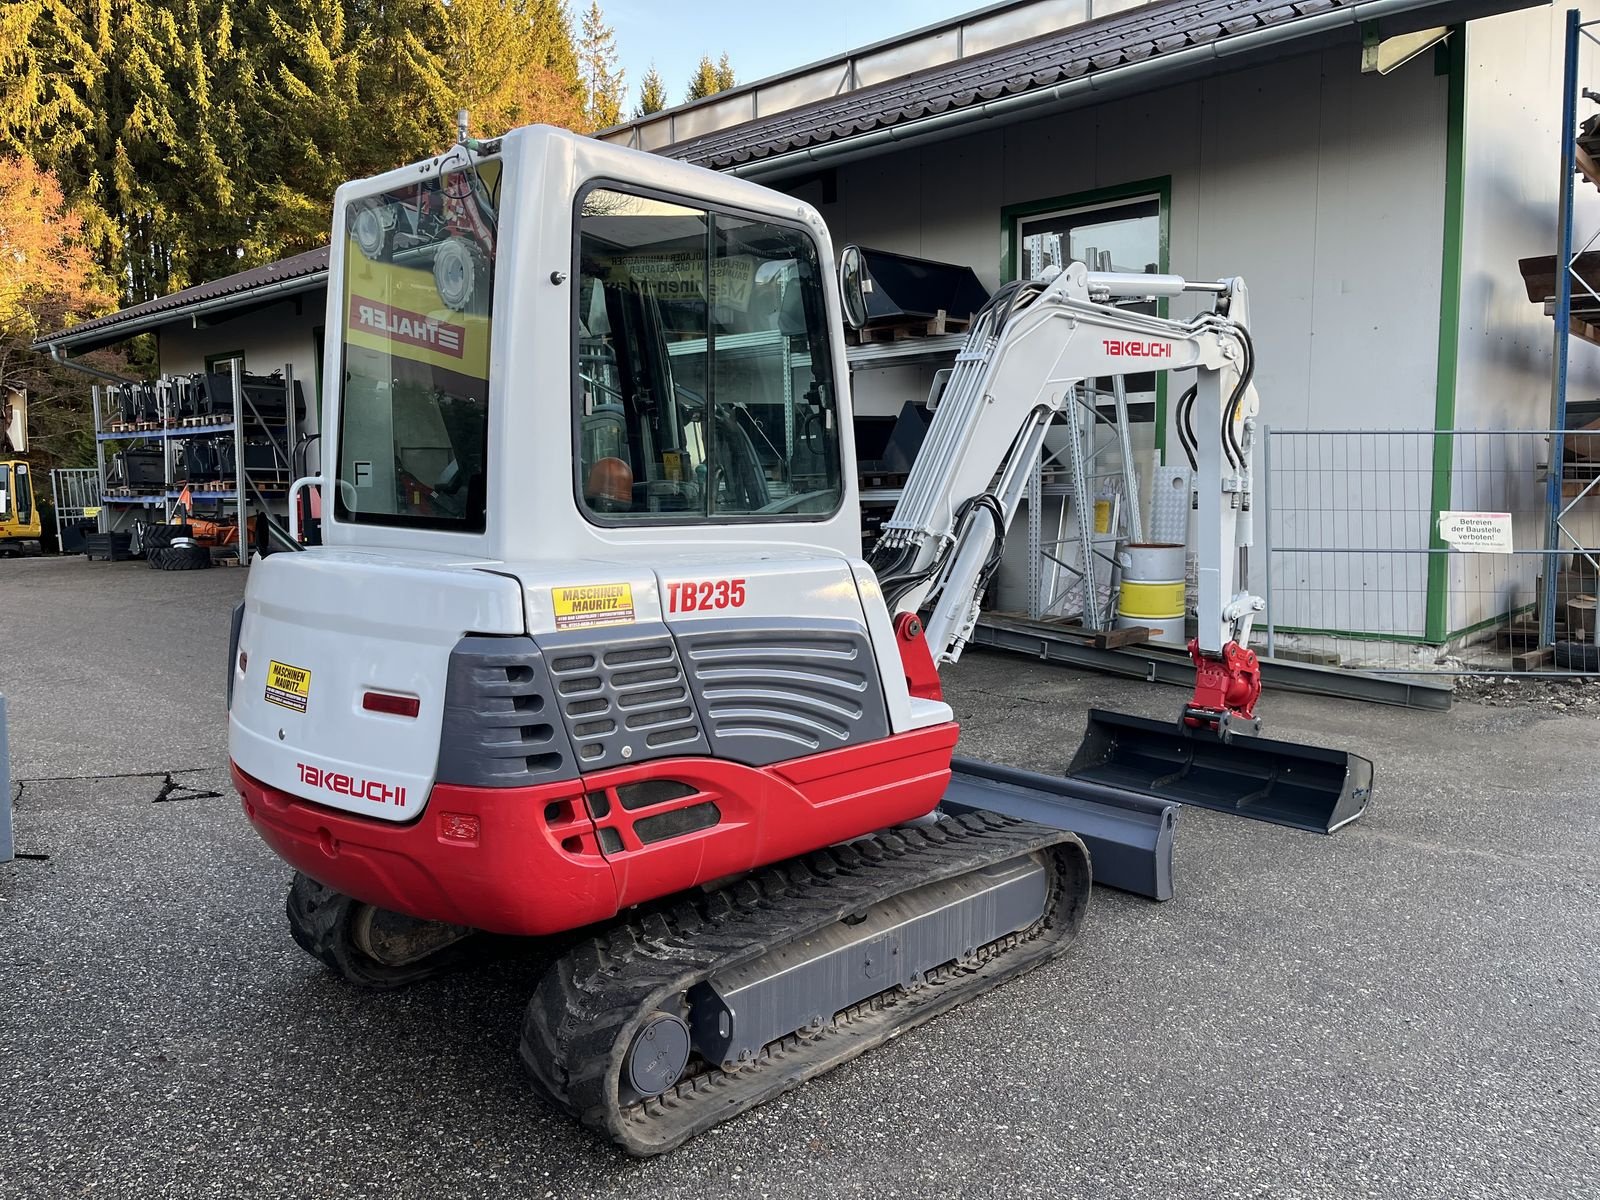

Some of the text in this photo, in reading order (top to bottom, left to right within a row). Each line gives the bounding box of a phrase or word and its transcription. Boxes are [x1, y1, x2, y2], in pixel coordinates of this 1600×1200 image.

[355, 463, 370, 485] F
[1459, 533, 1494, 541] verboten!
[563, 586, 624, 601] MASCHINEN
[667, 579, 746, 613] TB235
[572, 598, 617, 612] MAURITZ
[273, 664, 306, 683] MASCHINEN
[275, 676, 299, 692] MAURITZ
